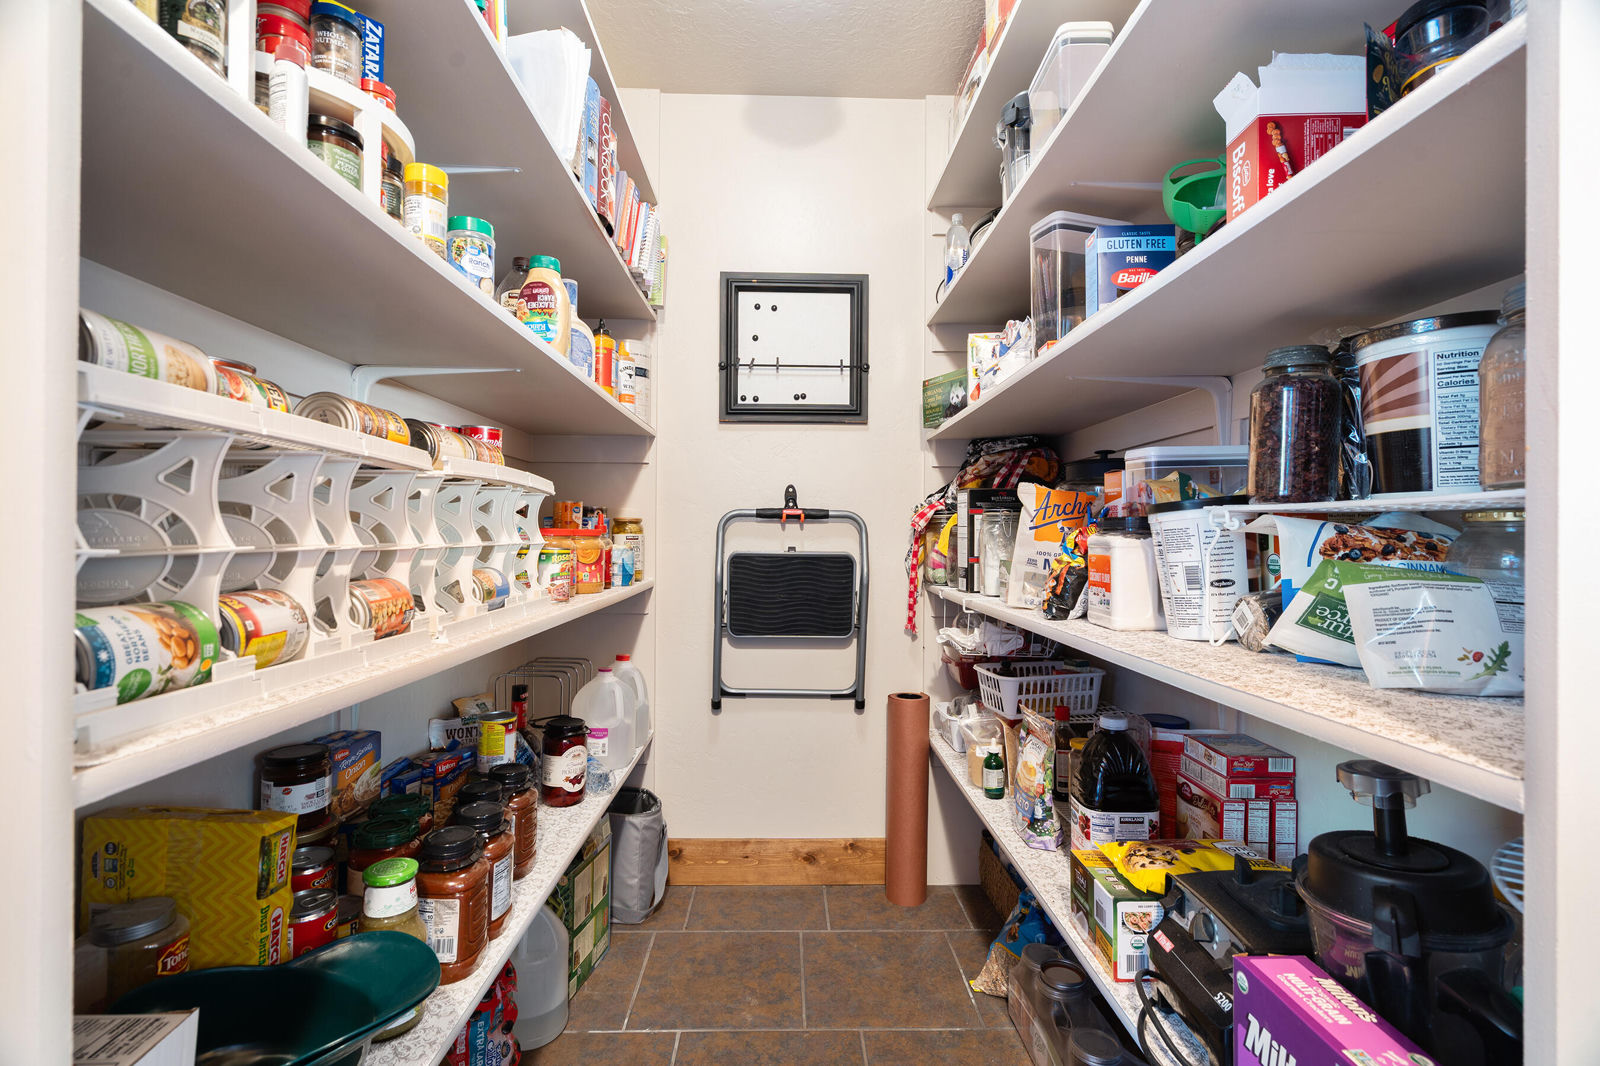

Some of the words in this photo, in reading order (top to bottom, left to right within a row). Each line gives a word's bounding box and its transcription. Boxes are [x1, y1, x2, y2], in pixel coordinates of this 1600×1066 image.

[316, 30, 346, 42] WHOLE
[315, 37, 349, 50] NUTMEG
[365, 19, 383, 82] ZATARA
[600, 112, 611, 199] COOKBOOK
[1266, 168, 1275, 187] love
[1106, 240, 1142, 250] GLUTEN
[1146, 238, 1166, 248] FREE
[468, 257, 490, 269] Ranch
[1126, 256, 1148, 264] PENNE
[1118, 272, 1155, 284] Barill
[1436, 350, 1480, 360] Nutrition
[1437, 378, 1475, 387] Calories
[1397, 562, 1447, 574] CINNAM
[116, 632, 133, 665] GREAT
[134, 629, 150, 662] BEANS
[446, 726, 479, 740] WONT
[335, 752, 350, 760] Lipton
[345, 760, 366, 780] Onion
[438, 762, 456, 772] Lipton
[278, 835, 289, 880] HATCH
[1214, 991, 1233, 1012] 5200
[1283, 972, 1352, 1025] MULTI-GRAIN
[476, 1022, 484, 1050] EXTRA
